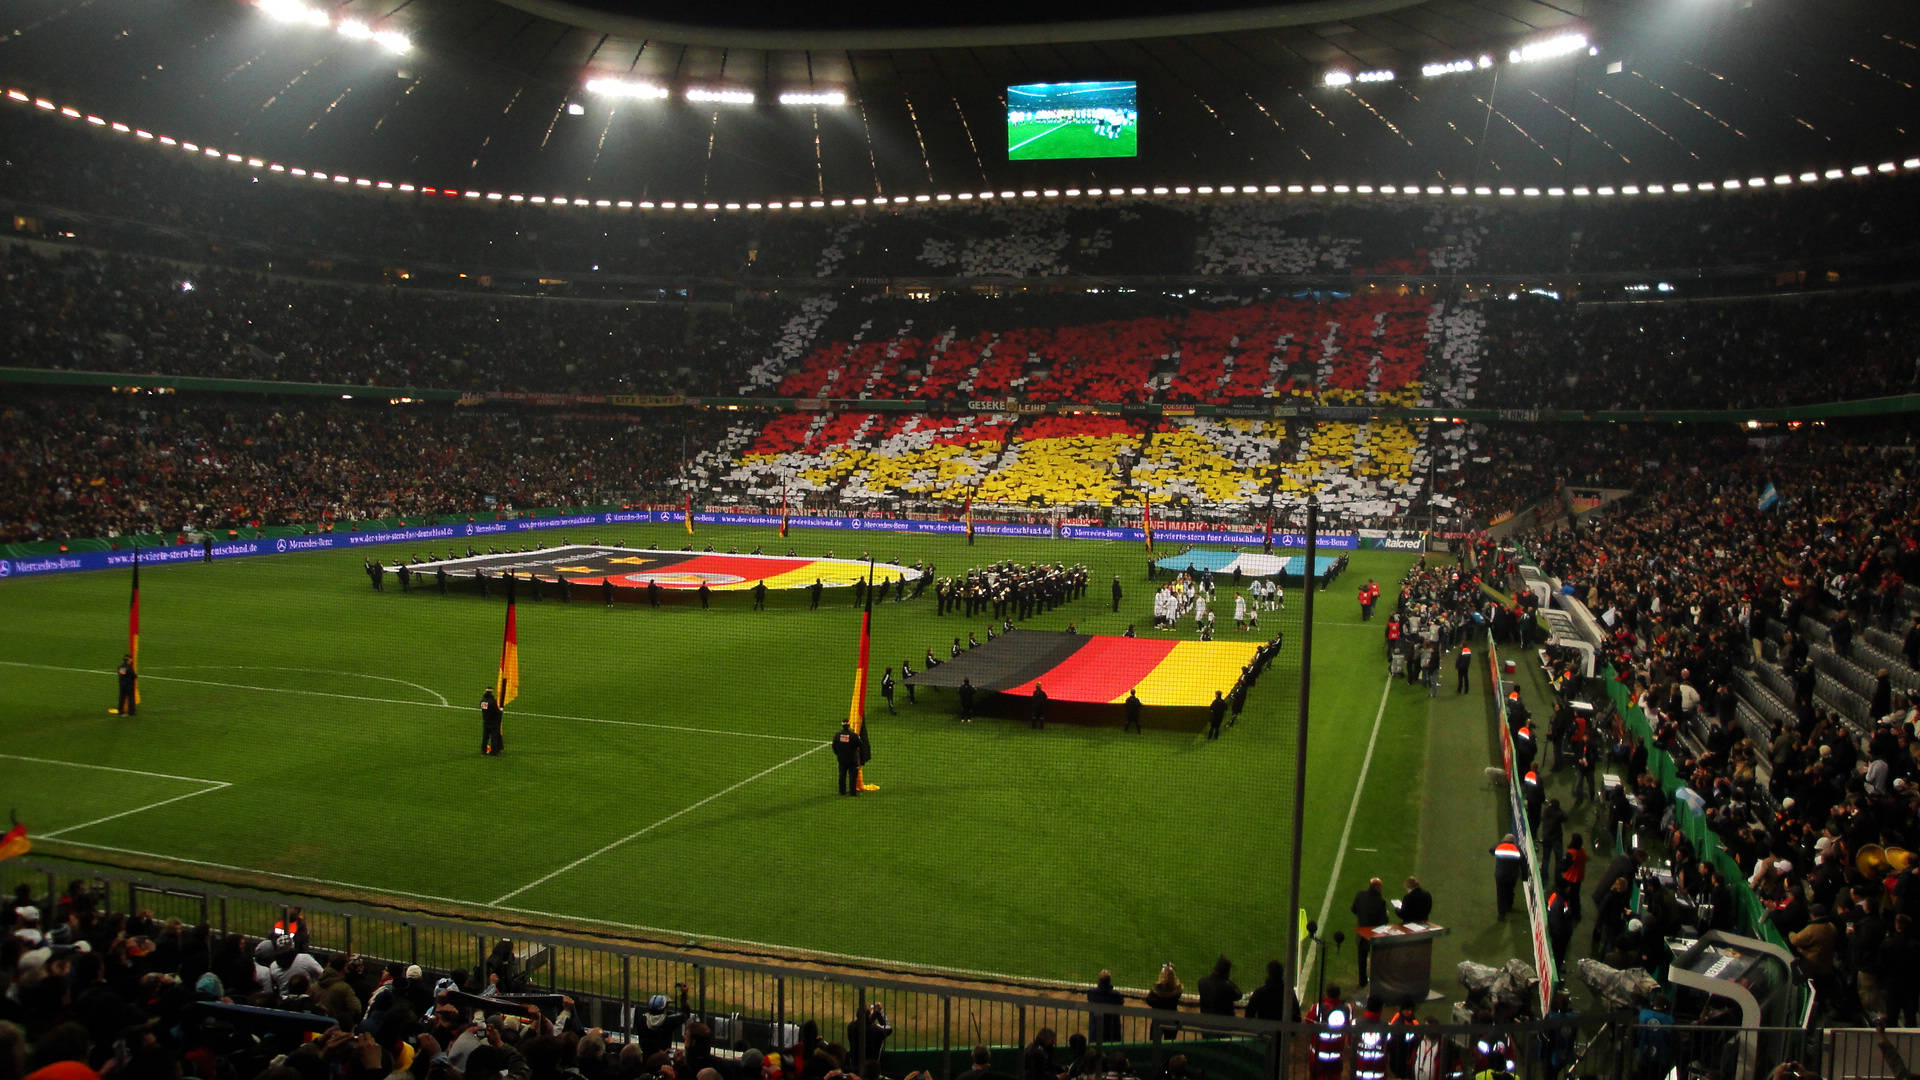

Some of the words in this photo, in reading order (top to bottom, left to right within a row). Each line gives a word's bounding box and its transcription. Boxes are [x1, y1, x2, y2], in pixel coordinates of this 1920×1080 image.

[968, 401, 1006, 410] GESEKE
[673, 514, 715, 522] Meres-Benz
[864, 521, 909, 530] Mercedes-Benz
[1074, 530, 1123, 538] Mercedes-Benz
[289, 538, 333, 549] Mercedes-Benz
[1297, 538, 1349, 546] Medes-Benz
[16, 558, 81, 572] Mercedes-Benz
